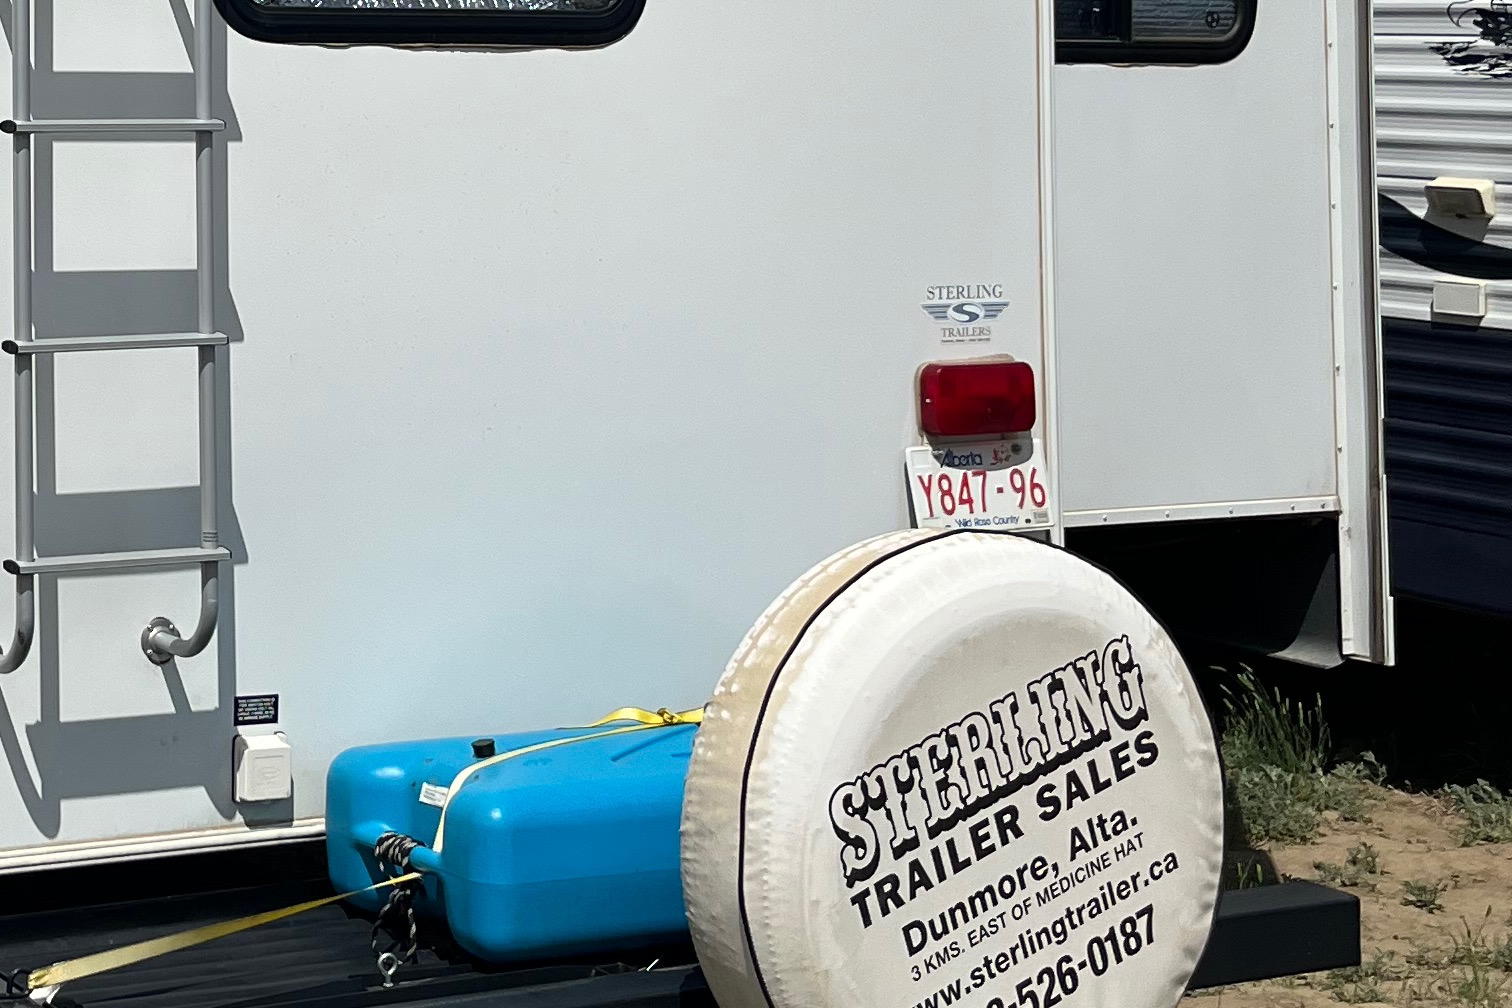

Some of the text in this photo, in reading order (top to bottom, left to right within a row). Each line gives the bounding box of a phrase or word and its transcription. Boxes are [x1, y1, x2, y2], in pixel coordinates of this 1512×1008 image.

[926, 284, 1003, 301] STERLING
[941, 326, 991, 338] TRAILERS
[917, 467, 1046, 518] Y847-96
[828, 634, 1149, 888] STERLING
[850, 730, 1159, 929] TRAILER SALES
[901, 810, 1139, 958] Dunmore, Alta.
[911, 832, 1145, 982] 3 KMS. EAST OF MEDICINE HAT
